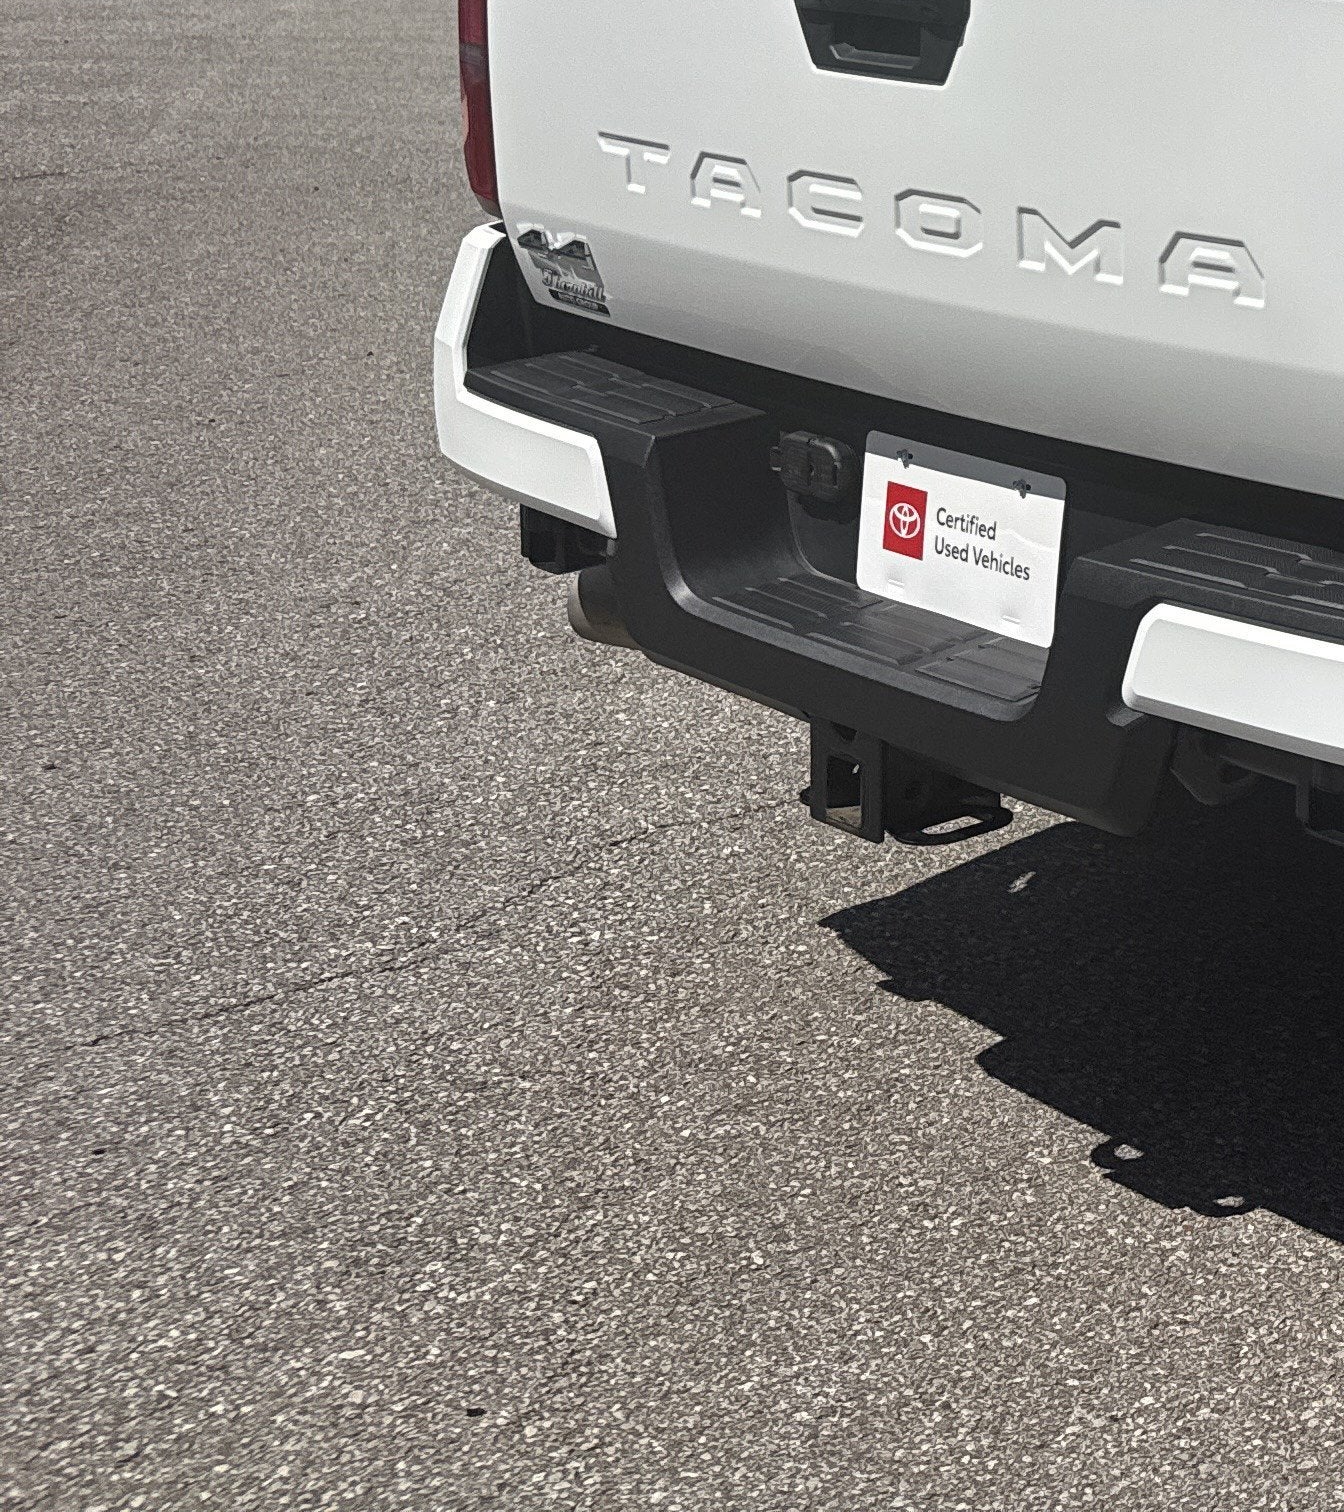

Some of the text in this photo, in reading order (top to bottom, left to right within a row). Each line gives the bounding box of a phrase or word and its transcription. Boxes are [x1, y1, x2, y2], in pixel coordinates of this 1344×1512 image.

[597, 130, 1266, 309] TACOMA
[936, 507, 997, 541] Certified
[934, 535, 1031, 581] Used Vehicles
